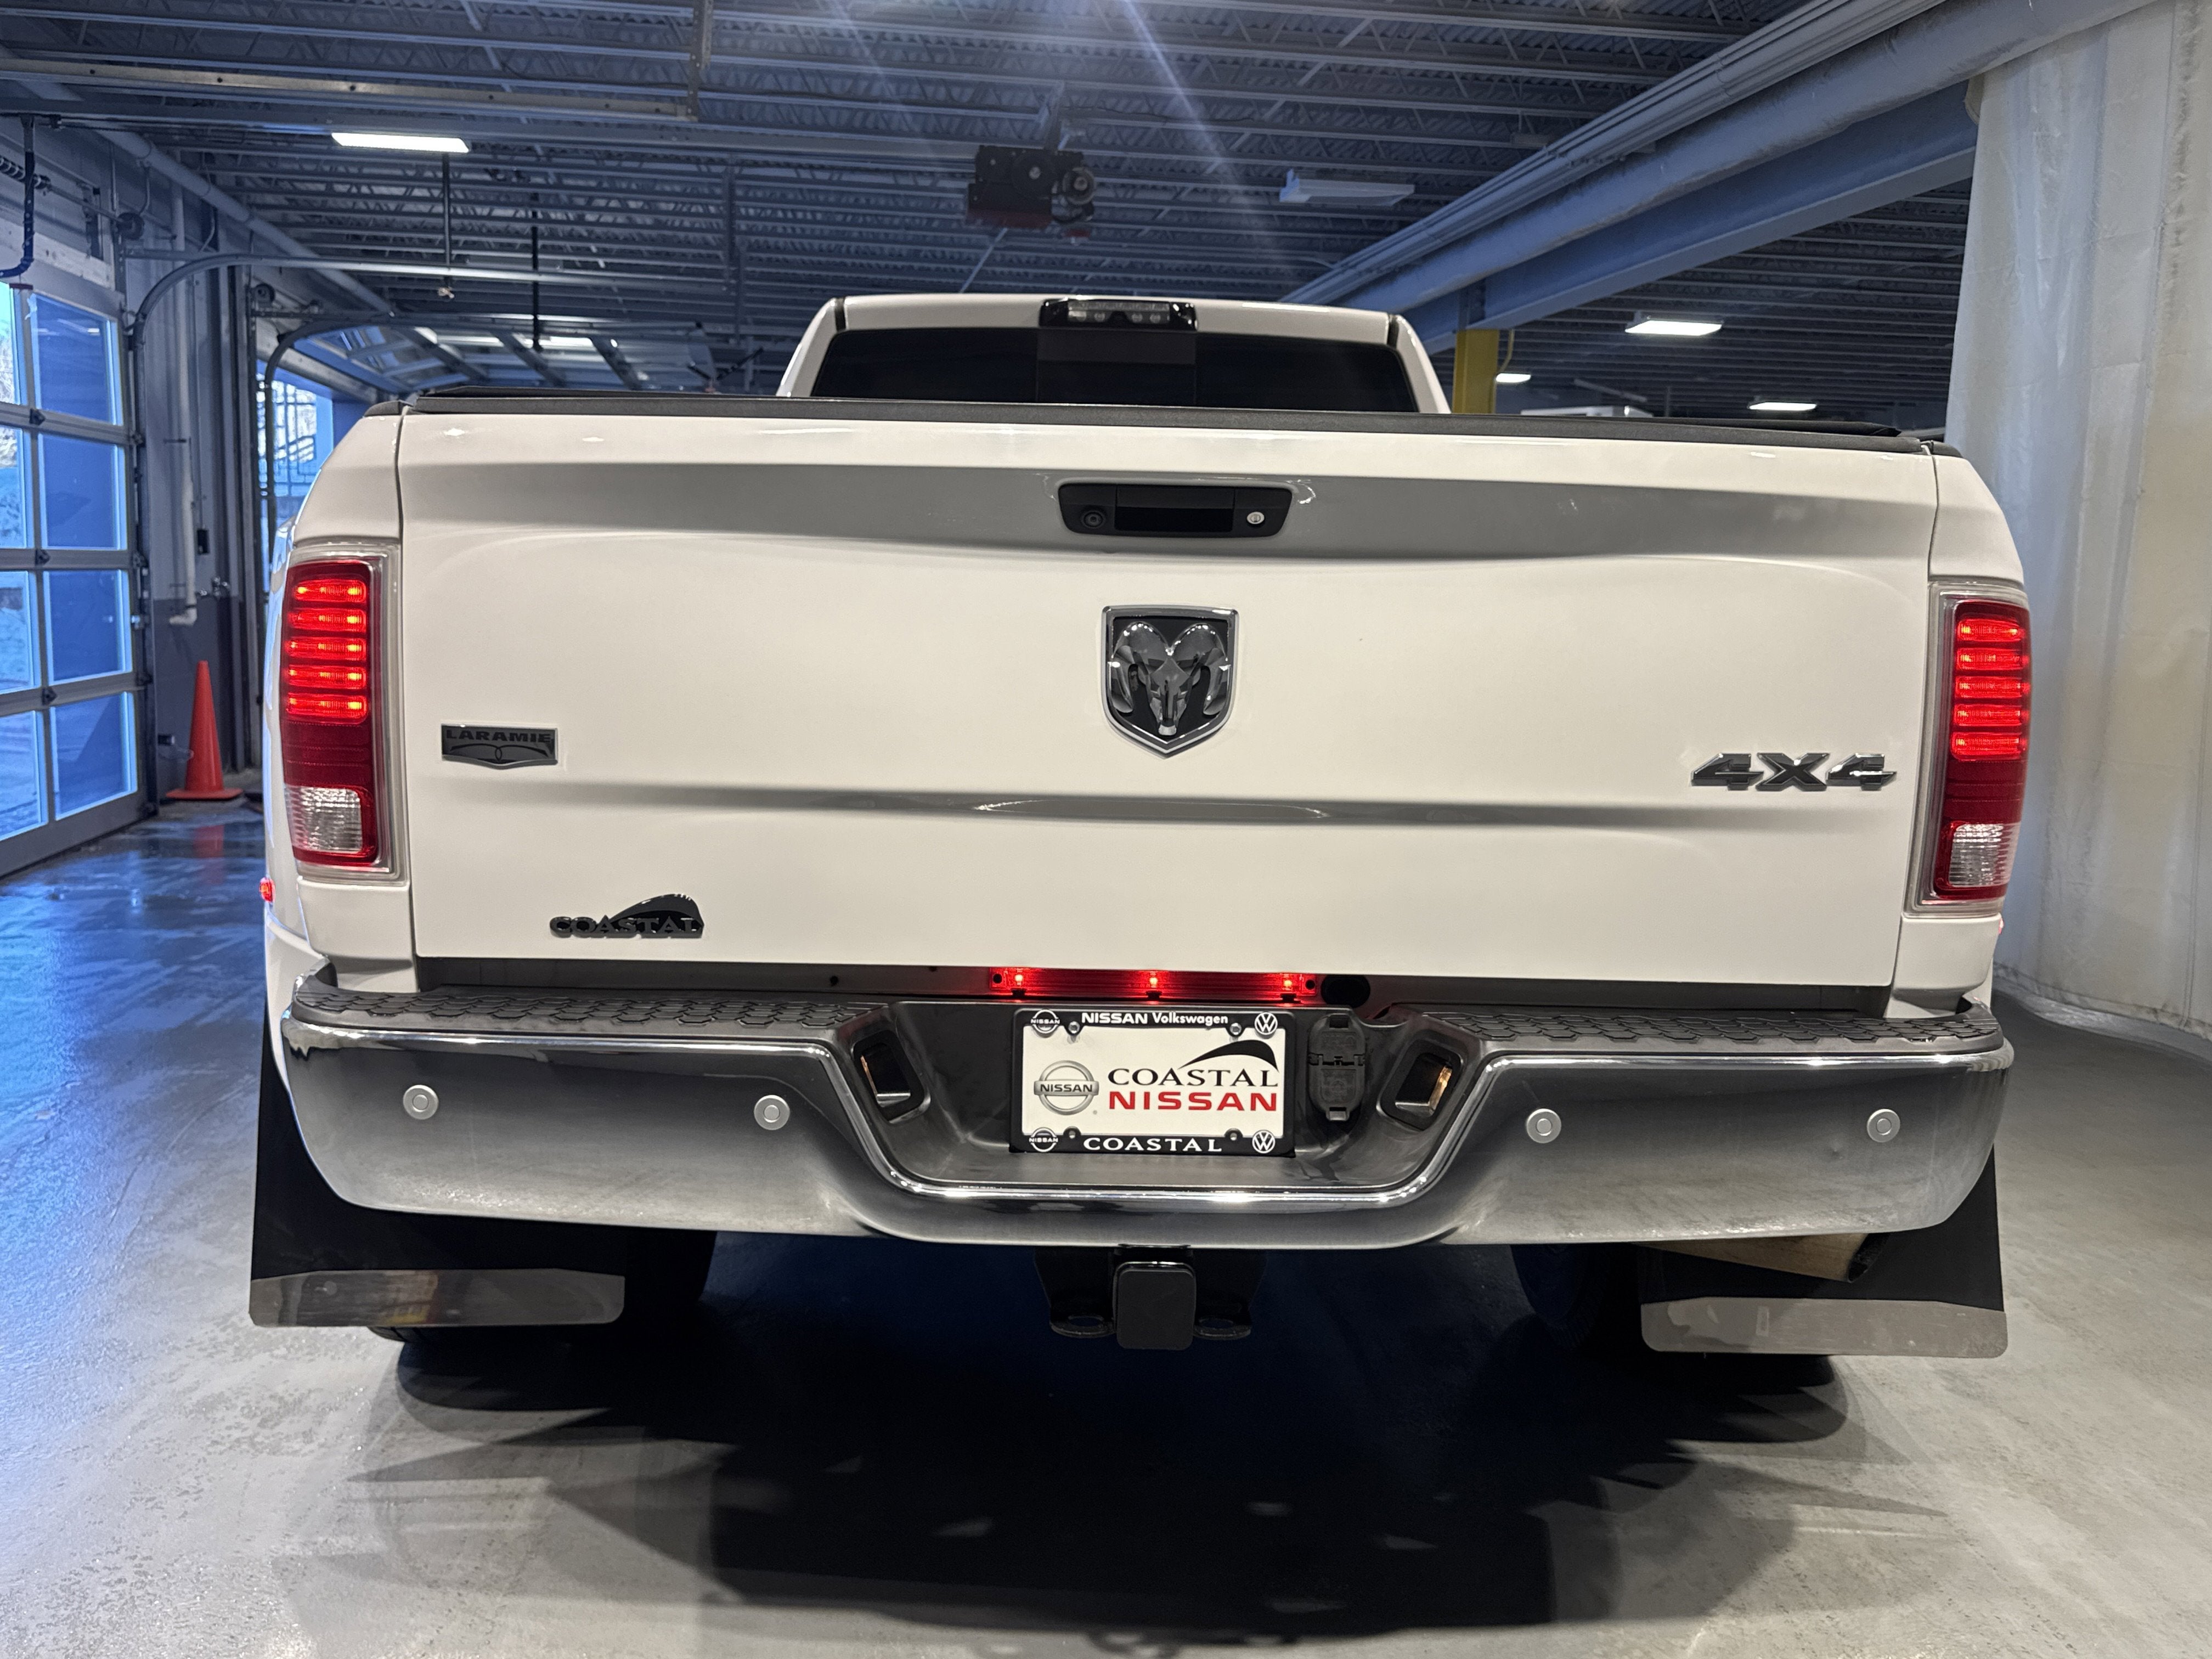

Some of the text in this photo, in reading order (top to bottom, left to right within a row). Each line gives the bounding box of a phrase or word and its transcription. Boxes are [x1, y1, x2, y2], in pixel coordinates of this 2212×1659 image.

[446, 730, 551, 743] LARAMIE
[1691, 752, 1897, 791] 4X4
[549, 915, 703, 939] COASTAL
[1081, 1012, 1228, 1026] NISSAN Volkswagen
[1108, 1068, 1279, 1087] COASTAL
[1040, 1084, 1093, 1093] NISSAN
[1109, 1091, 1277, 1111] NISSAN
[1083, 1137, 1222, 1152] COASTAL
